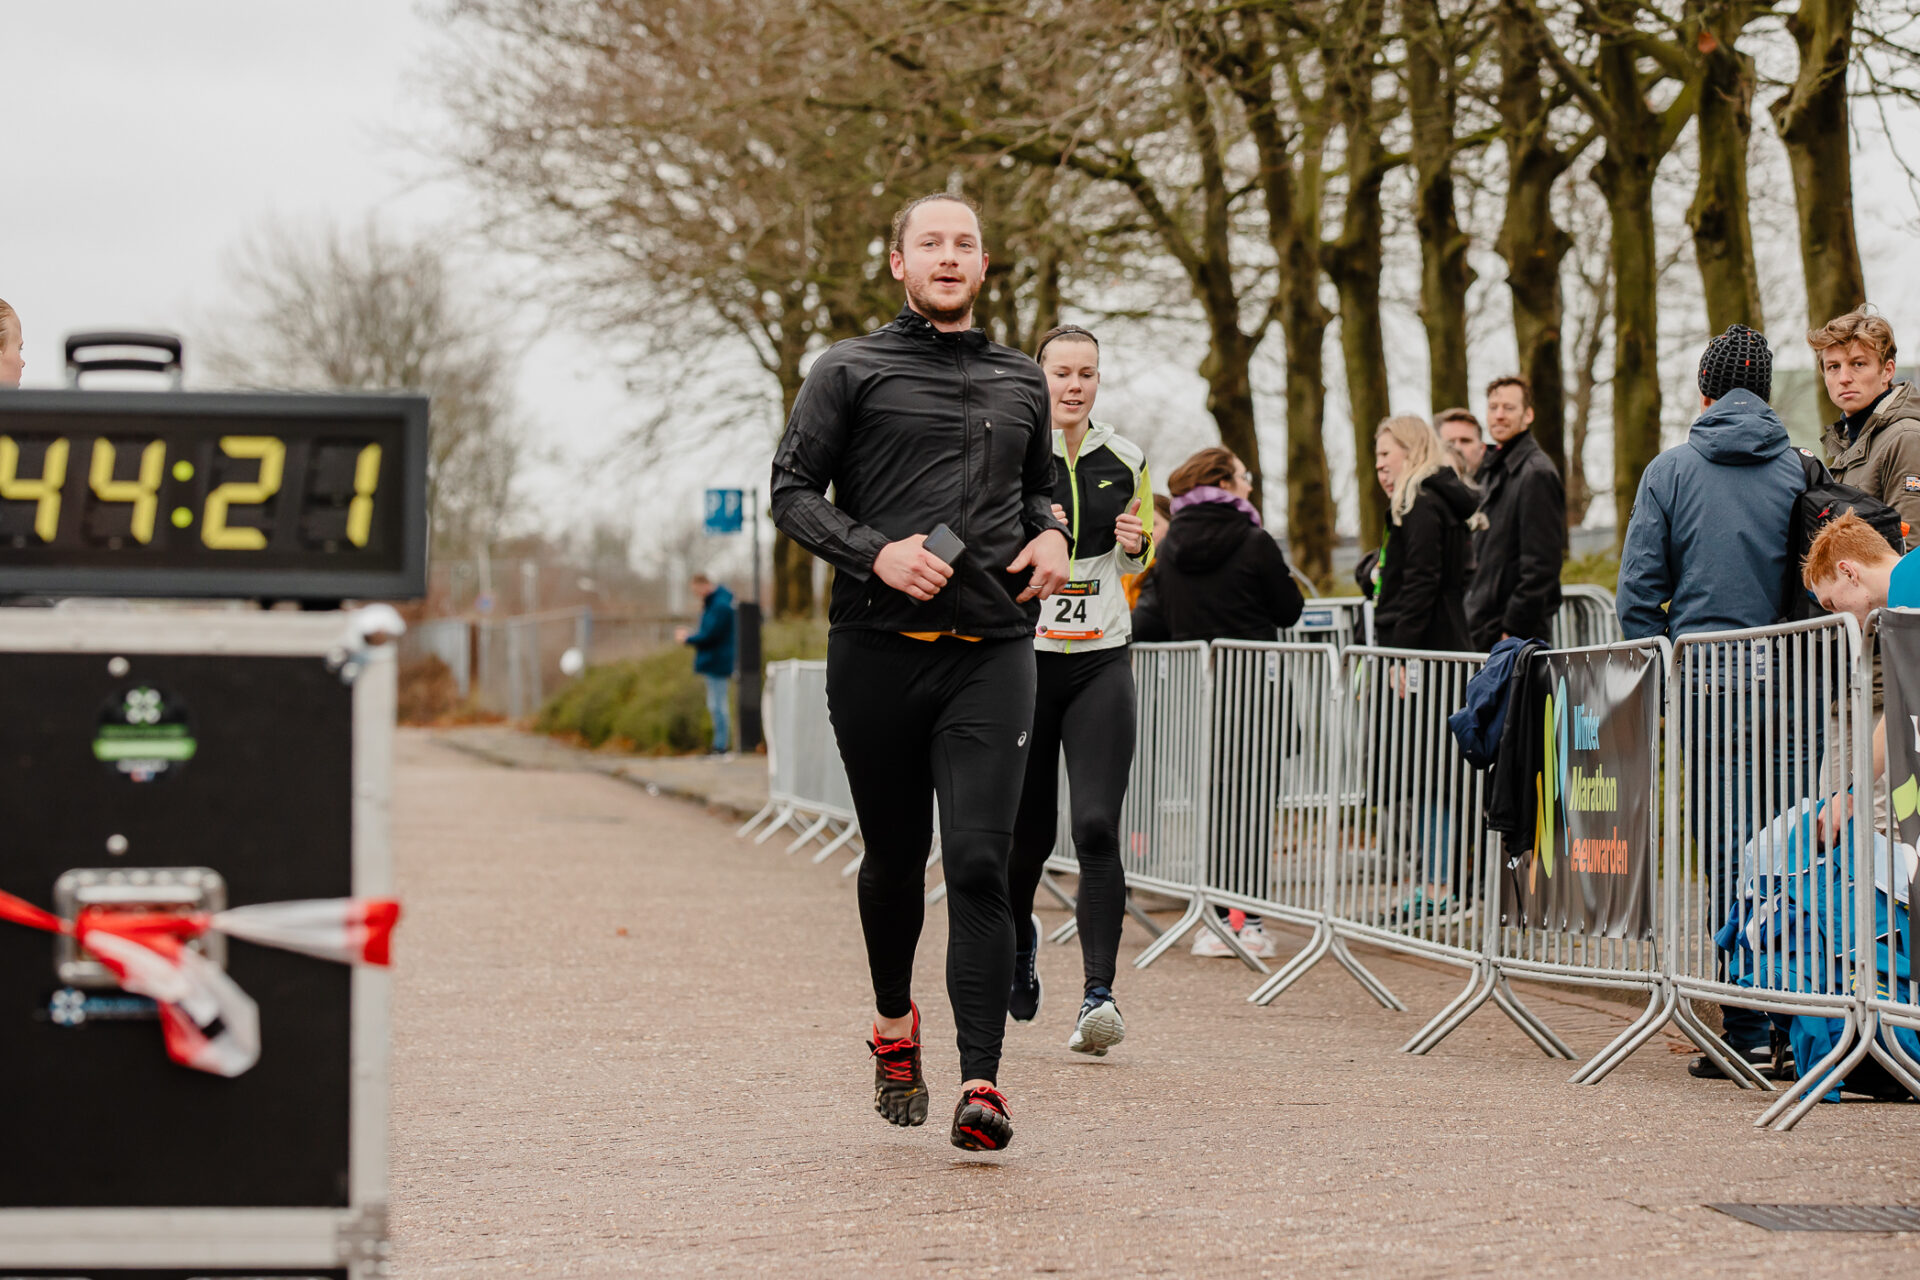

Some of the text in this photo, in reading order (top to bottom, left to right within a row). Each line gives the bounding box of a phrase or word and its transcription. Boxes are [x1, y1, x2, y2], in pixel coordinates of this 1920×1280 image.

[0, 435, 382, 550] 44:21
[1055, 598, 1087, 623] 24
[1569, 764, 1617, 811] Marathon
